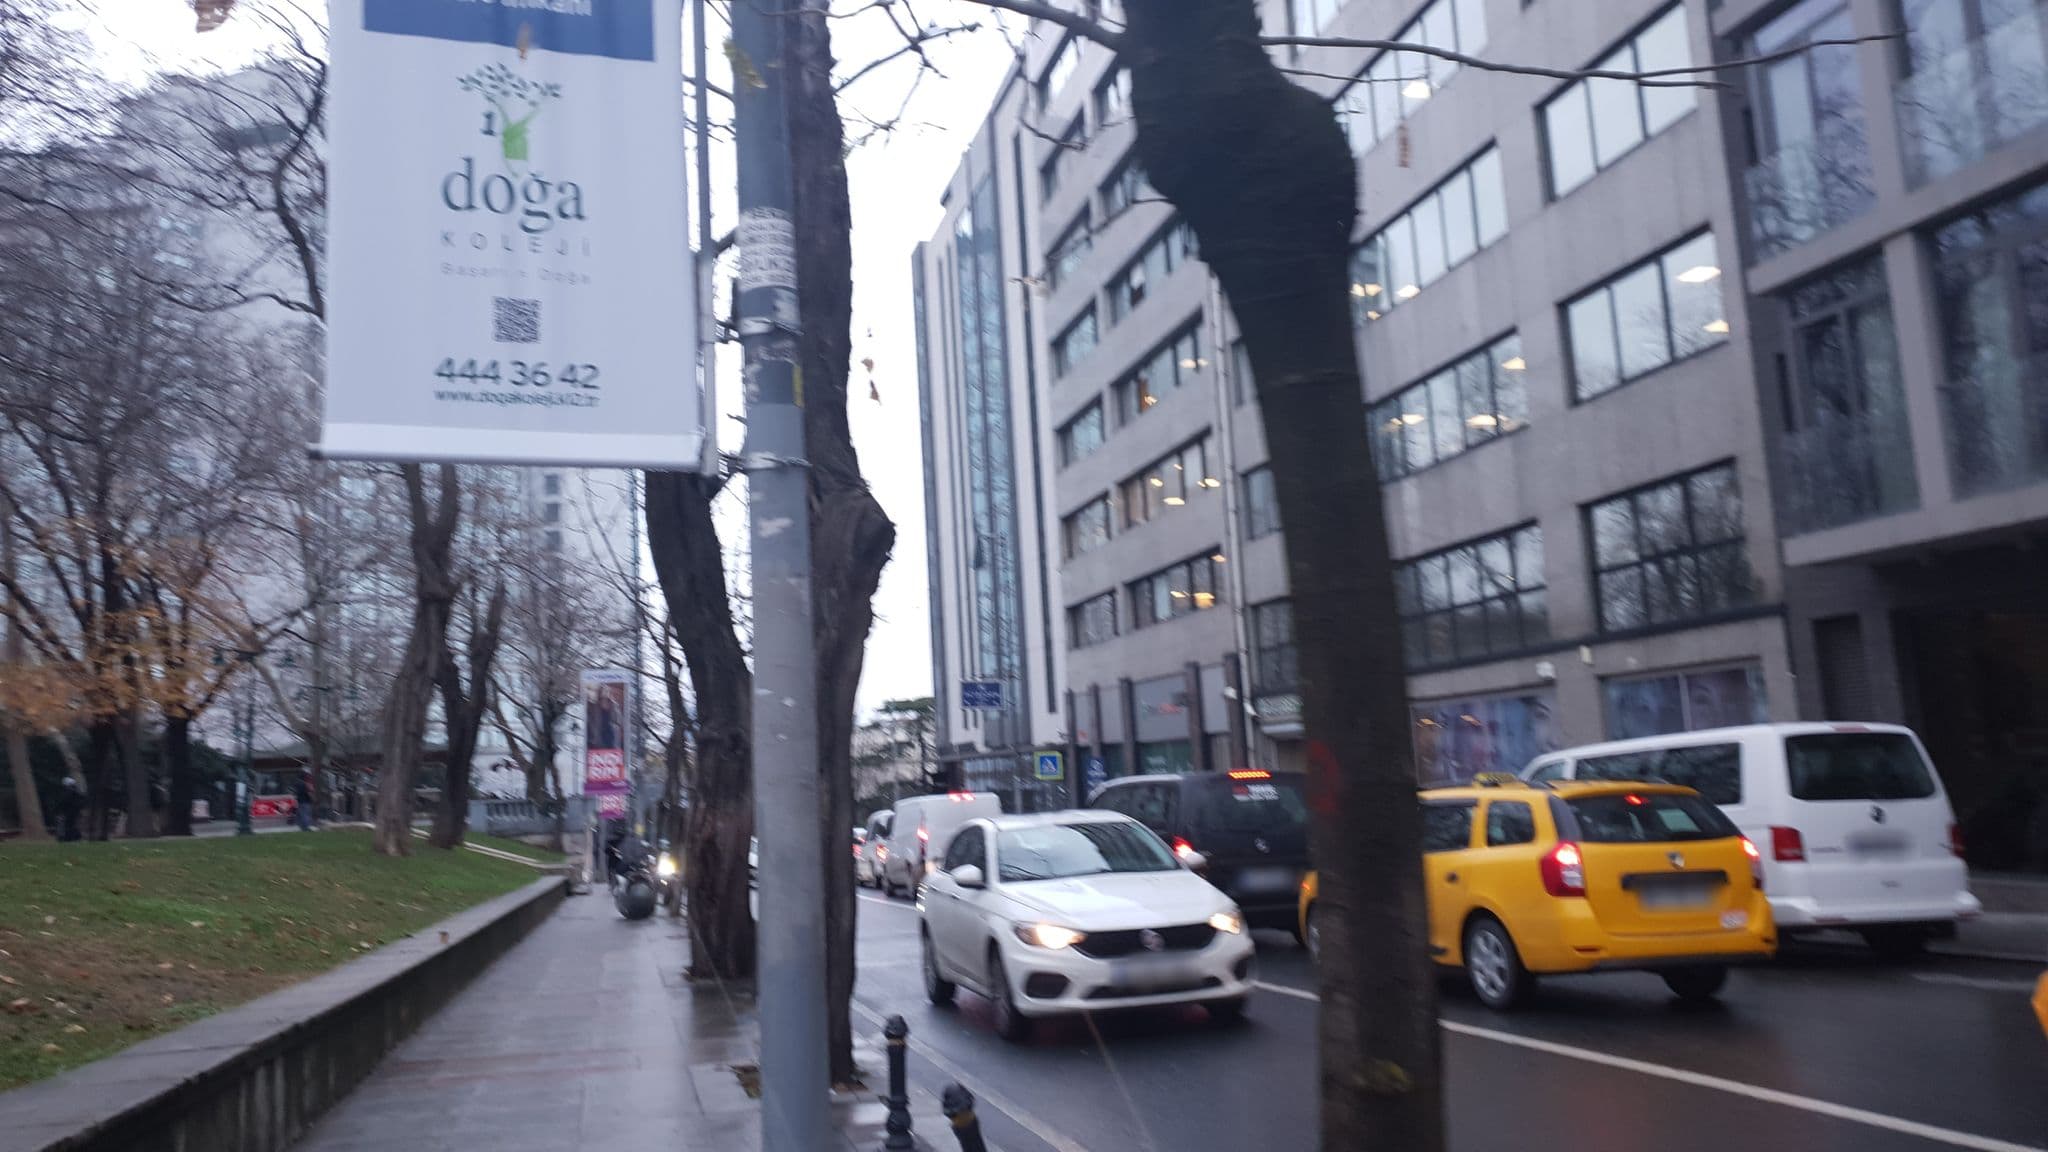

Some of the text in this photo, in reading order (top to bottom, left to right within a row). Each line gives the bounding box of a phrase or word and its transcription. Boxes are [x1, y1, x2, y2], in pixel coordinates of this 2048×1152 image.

[434, 357, 601, 390] 444 36 42
